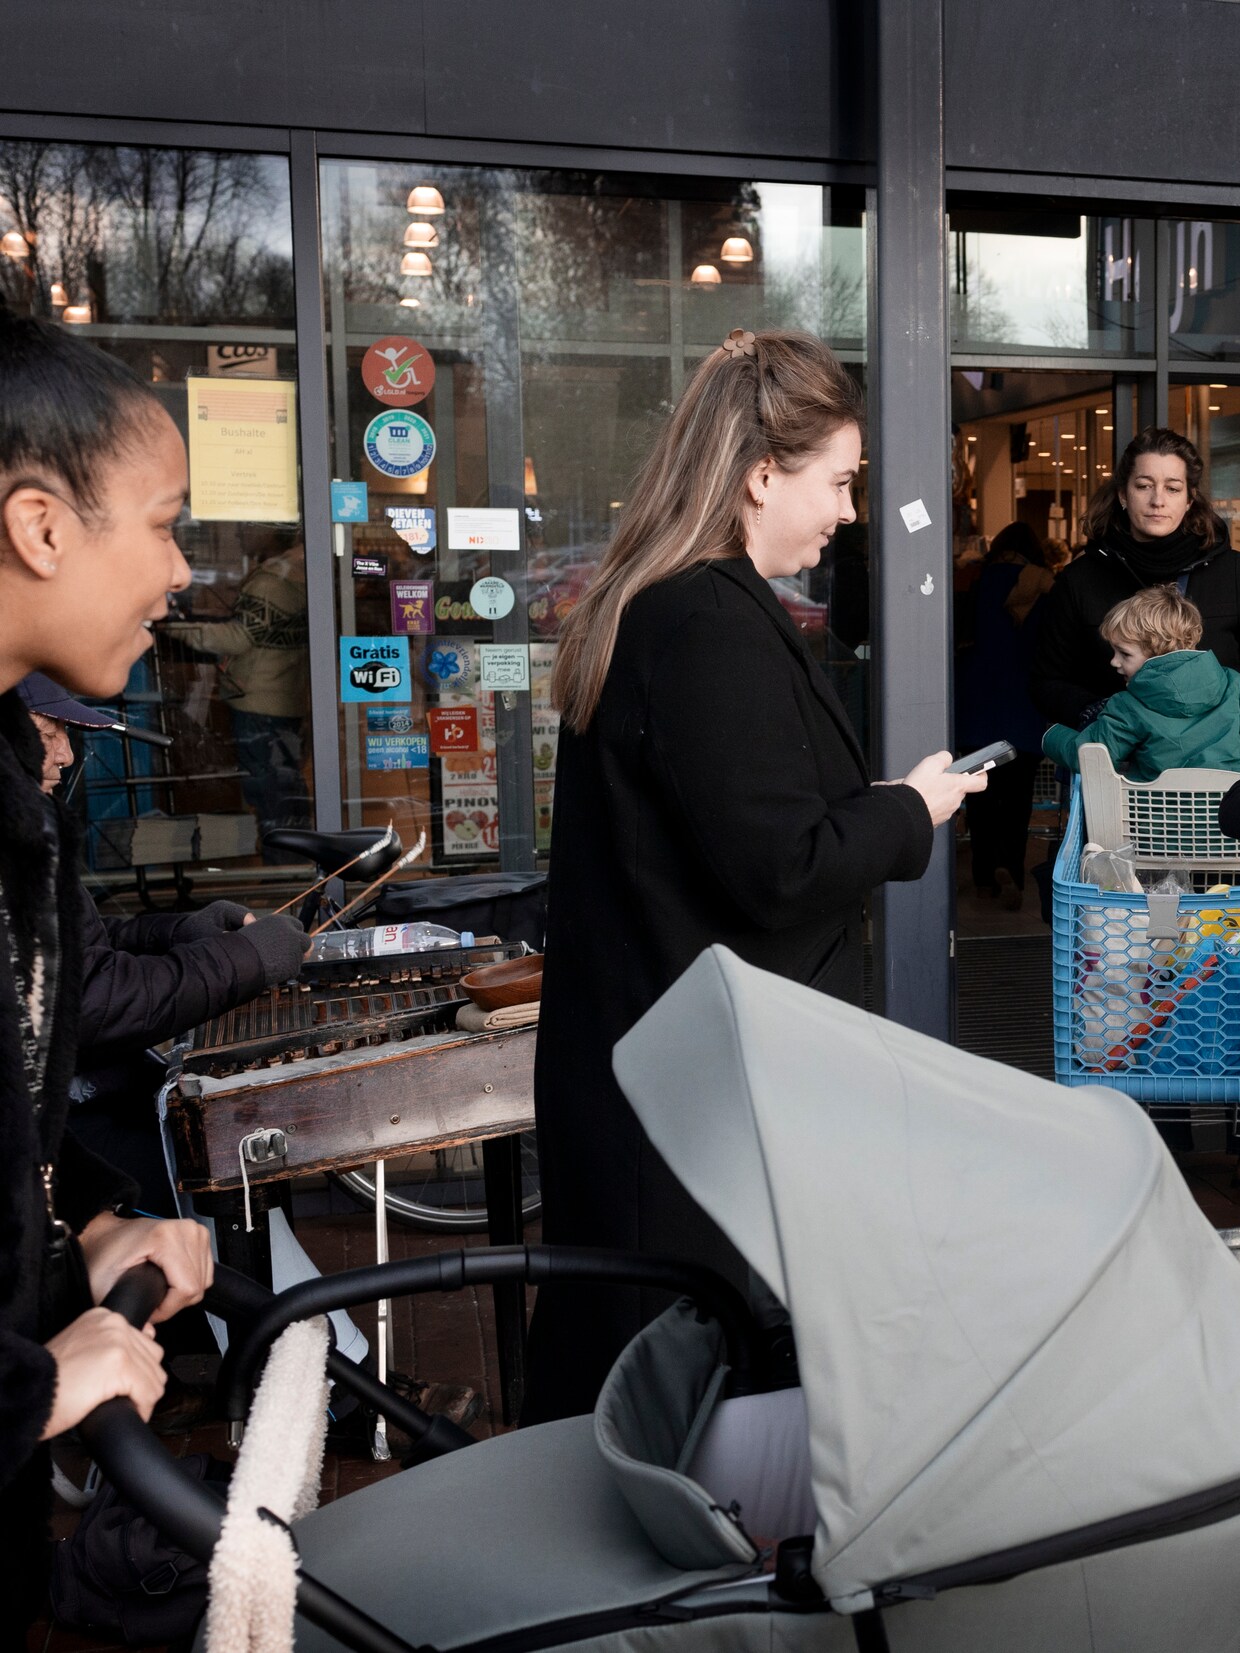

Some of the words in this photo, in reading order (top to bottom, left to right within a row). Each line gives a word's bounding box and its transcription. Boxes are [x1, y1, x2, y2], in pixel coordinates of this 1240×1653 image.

[220, 427, 266, 438] Bushalte
[387, 508, 425, 519] DIEVEN
[396, 590, 428, 599] WELKOM
[350, 645, 400, 659] Gratis
[368, 738, 383, 746] WIJ
[385, 737, 427, 746] VERKOPEN
[410, 745, 427, 754] <18
